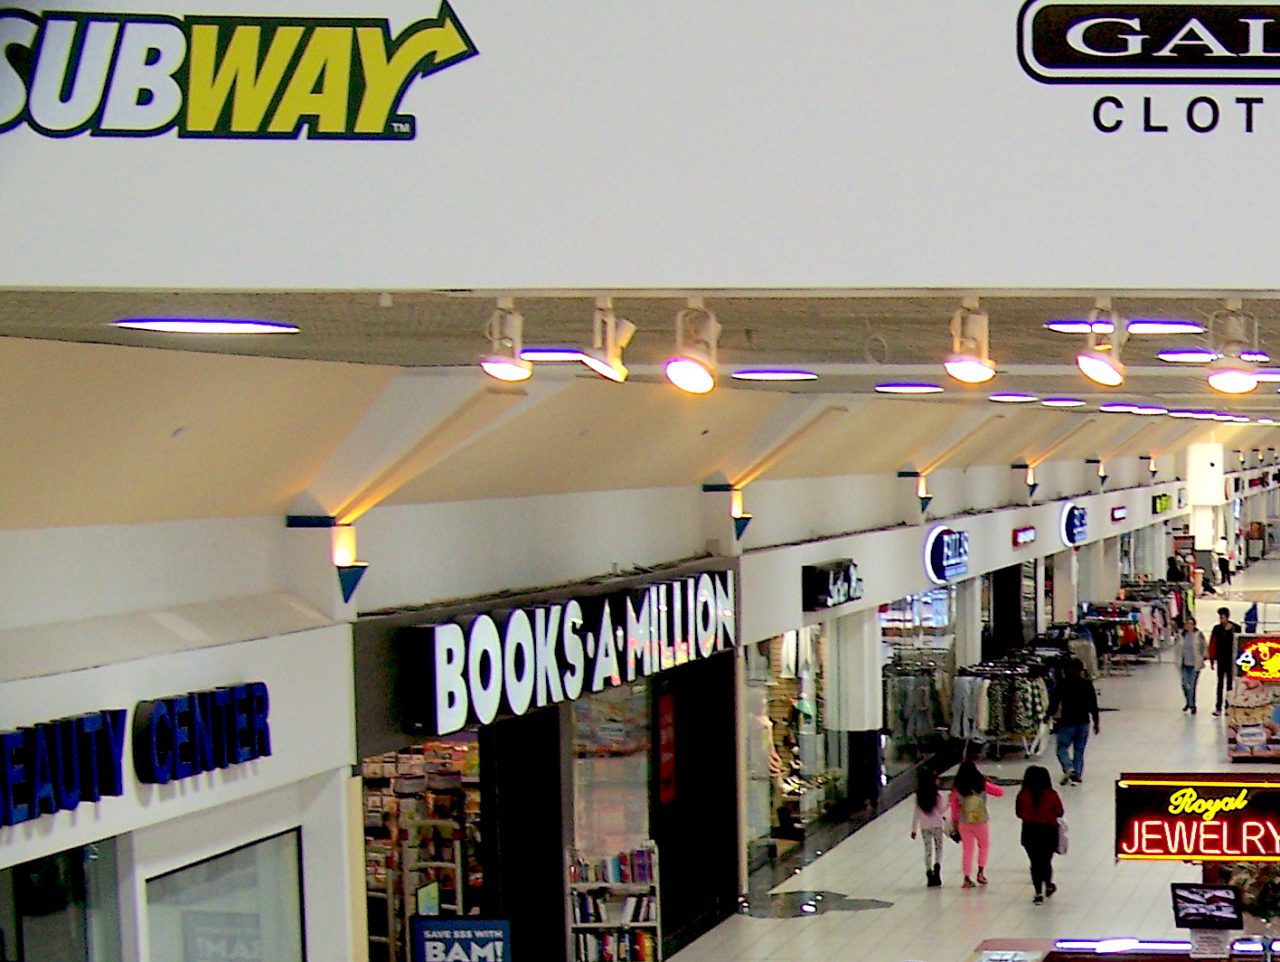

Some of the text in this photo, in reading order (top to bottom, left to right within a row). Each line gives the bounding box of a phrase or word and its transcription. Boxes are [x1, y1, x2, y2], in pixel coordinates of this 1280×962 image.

[0, 682, 272, 827] EAUTY CENTER
[1168, 787, 1248, 821] Royal
[424, 930, 451, 939] SAVE
[424, 941, 504, 962] BAM!
